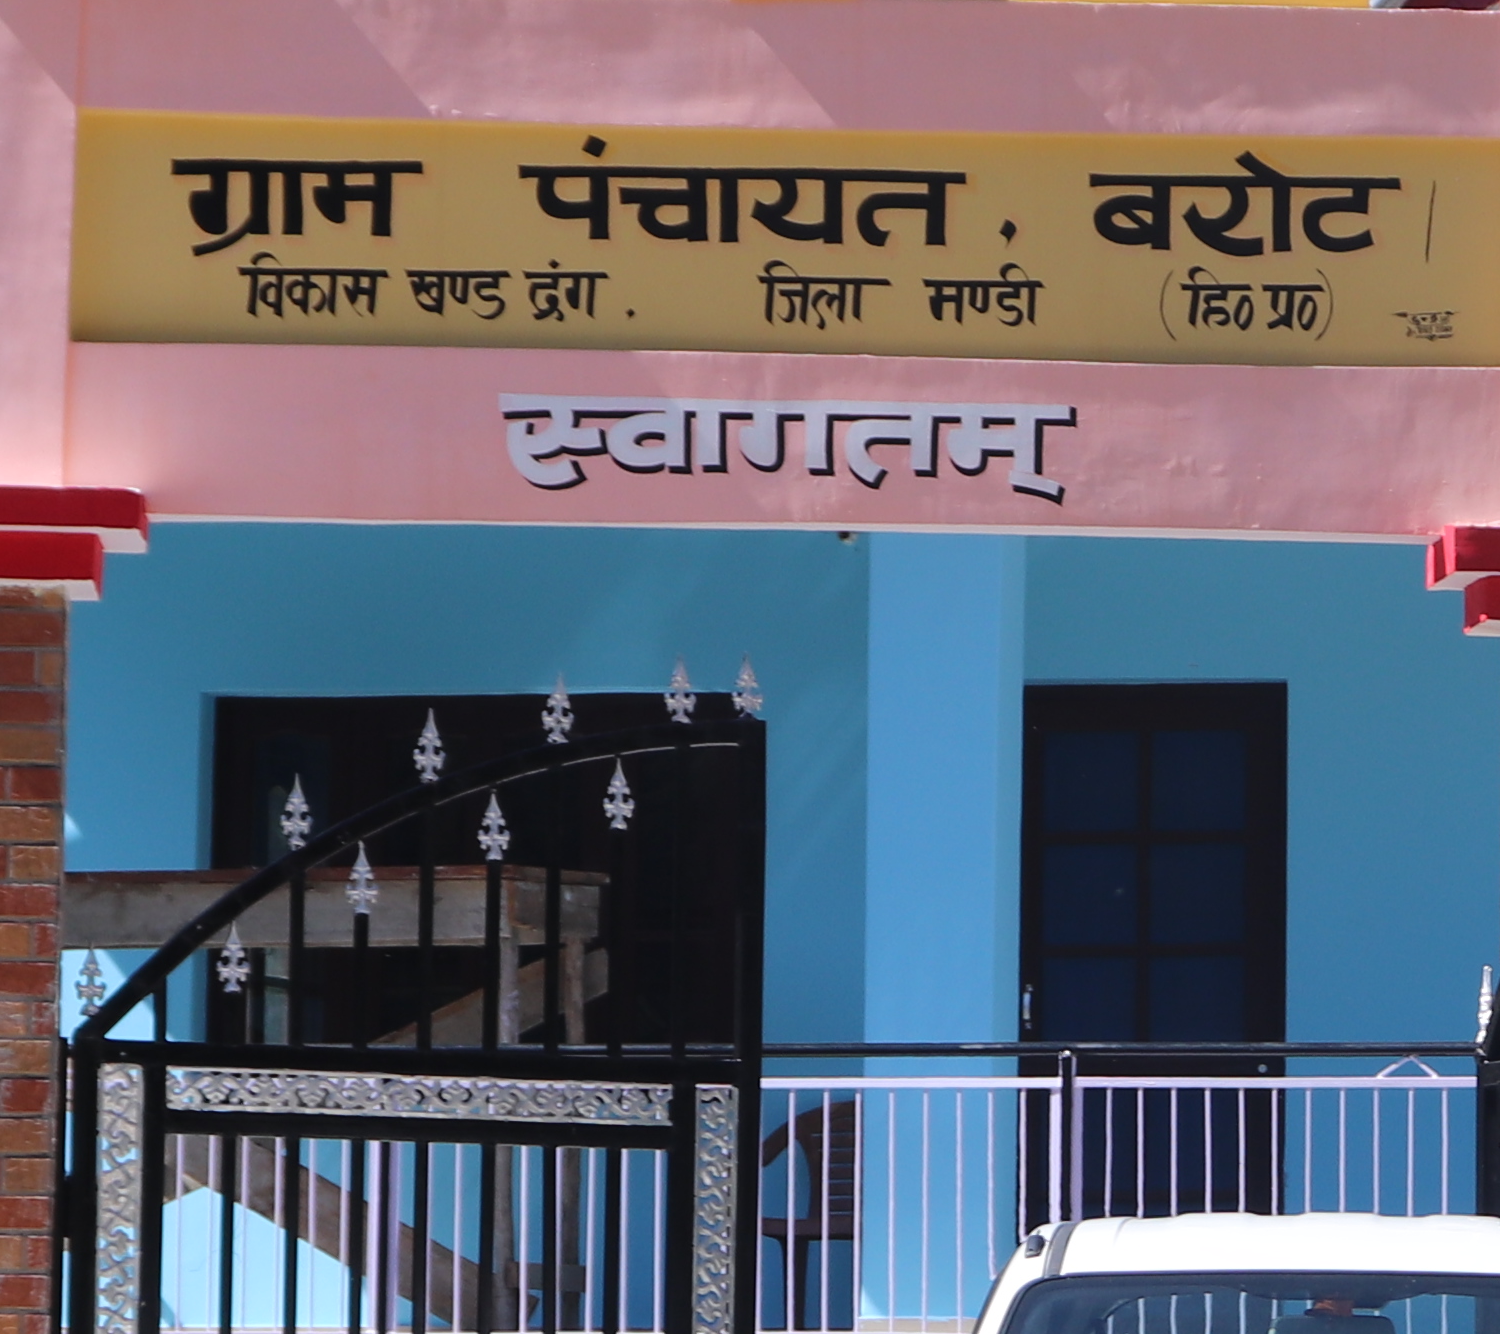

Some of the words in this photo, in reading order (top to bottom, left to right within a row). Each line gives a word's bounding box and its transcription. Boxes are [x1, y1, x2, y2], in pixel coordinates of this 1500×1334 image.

[171, 158, 423, 256] ग्राम
[519, 135, 967, 247] पंचायत
[1089, 151, 1401, 256] बरोट
[238, 251, 389, 319] विकास
[406, 269, 511, 320] खण्ड
[758, 260, 891, 329] जिला
[922, 262, 1045, 327] मण्डी
[499, 392, 1078, 505] स्वागतम्
